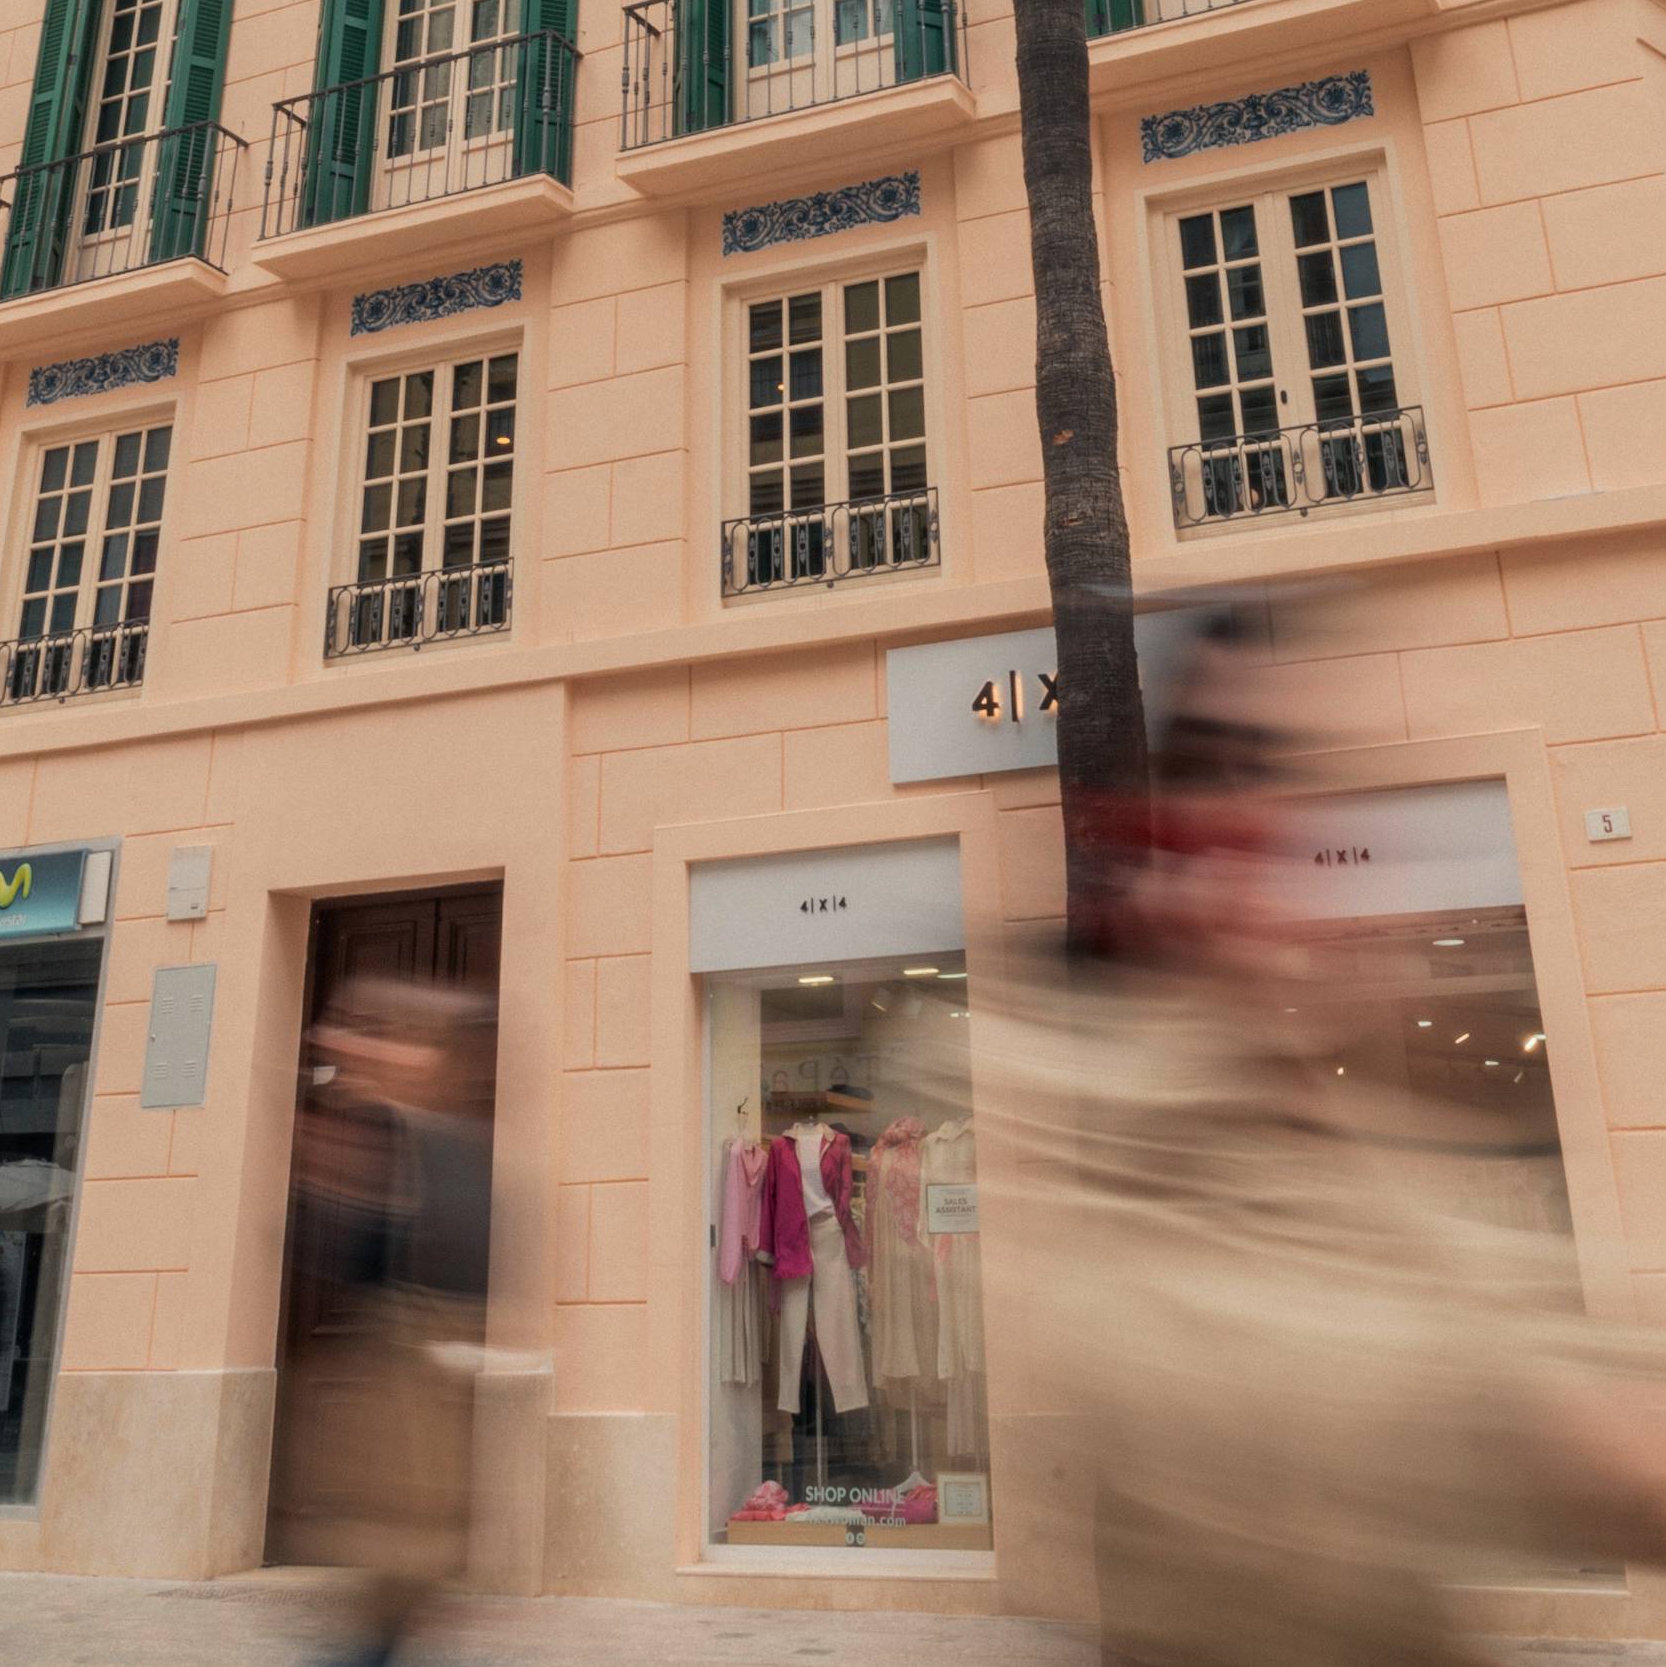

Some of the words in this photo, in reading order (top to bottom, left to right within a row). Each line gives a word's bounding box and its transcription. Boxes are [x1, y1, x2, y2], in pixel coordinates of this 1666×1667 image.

[1602, 814, 1613, 833] 5
[805, 1486, 846, 1502] SHOP
[849, 1487, 906, 1504] ONLINE
